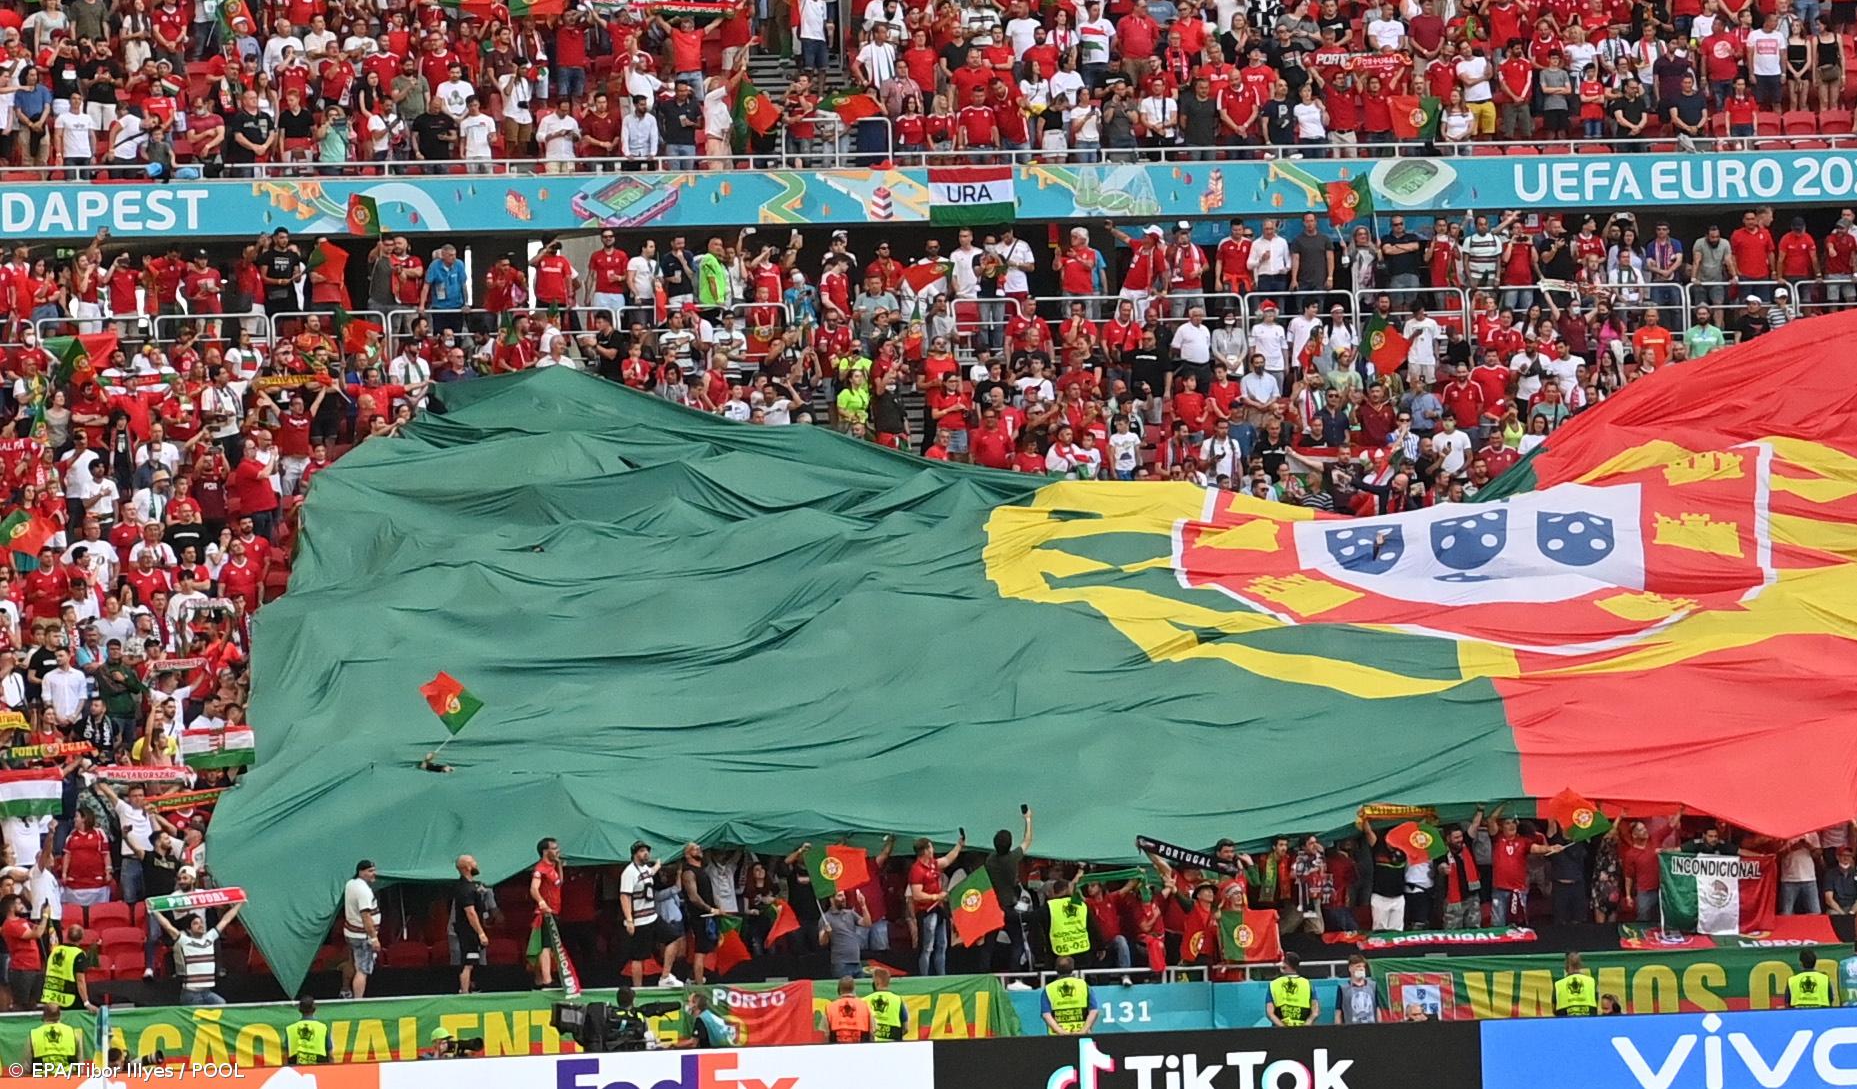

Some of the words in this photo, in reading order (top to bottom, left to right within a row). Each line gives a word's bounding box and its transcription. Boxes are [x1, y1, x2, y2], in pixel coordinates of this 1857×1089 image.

[1514, 162, 1643, 202] UEFA
[1651, 157, 1782, 200] EURO
[947, 185, 993, 203] URA
[2, 189, 209, 233] DAPEST
[158, 791, 219, 808] PORTUGAL
[1158, 844, 1212, 869] PORTUGAL
[1671, 856, 1762, 881] INCONDICIONAL
[168, 890, 230, 910] PORTUGAL
[1392, 932, 1501, 945] PORTUGAL
[712, 988, 786, 1008] PORTO
[1102, 1001, 1152, 1023] 131
[1124, 1048, 1354, 1089] TikTok
